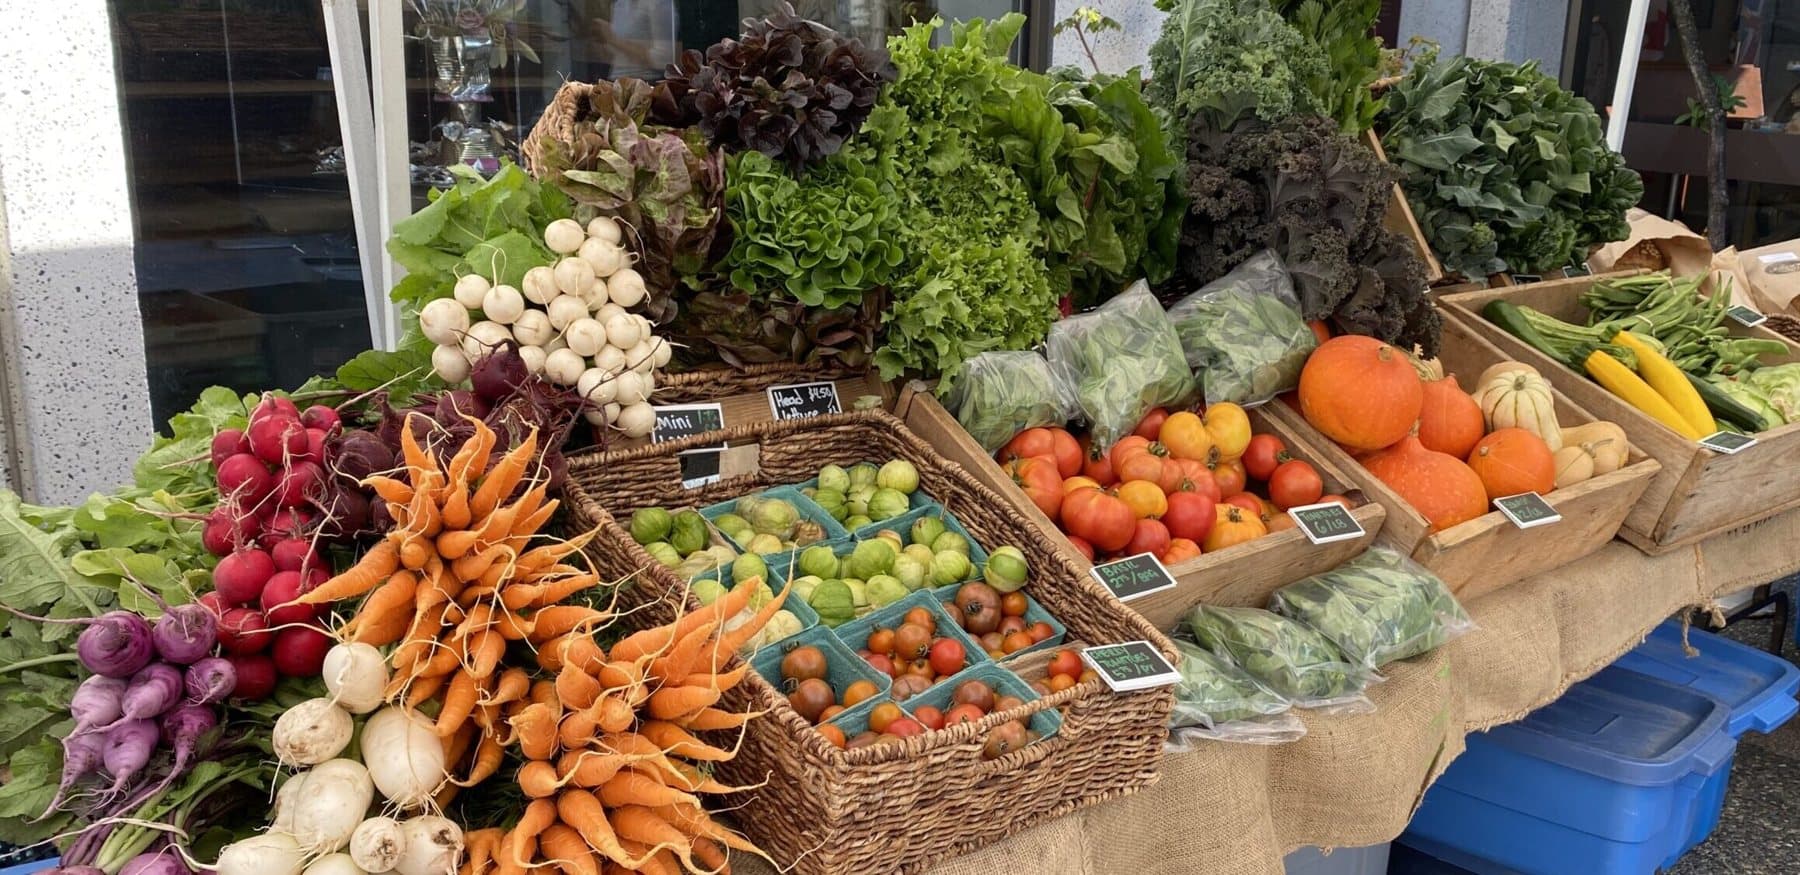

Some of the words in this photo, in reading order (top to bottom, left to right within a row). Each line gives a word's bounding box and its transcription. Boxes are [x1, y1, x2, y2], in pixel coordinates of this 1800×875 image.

[773, 388, 804, 408] Head
[656, 414, 693, 431] Mini
[1101, 561, 1141, 577] BASIL
